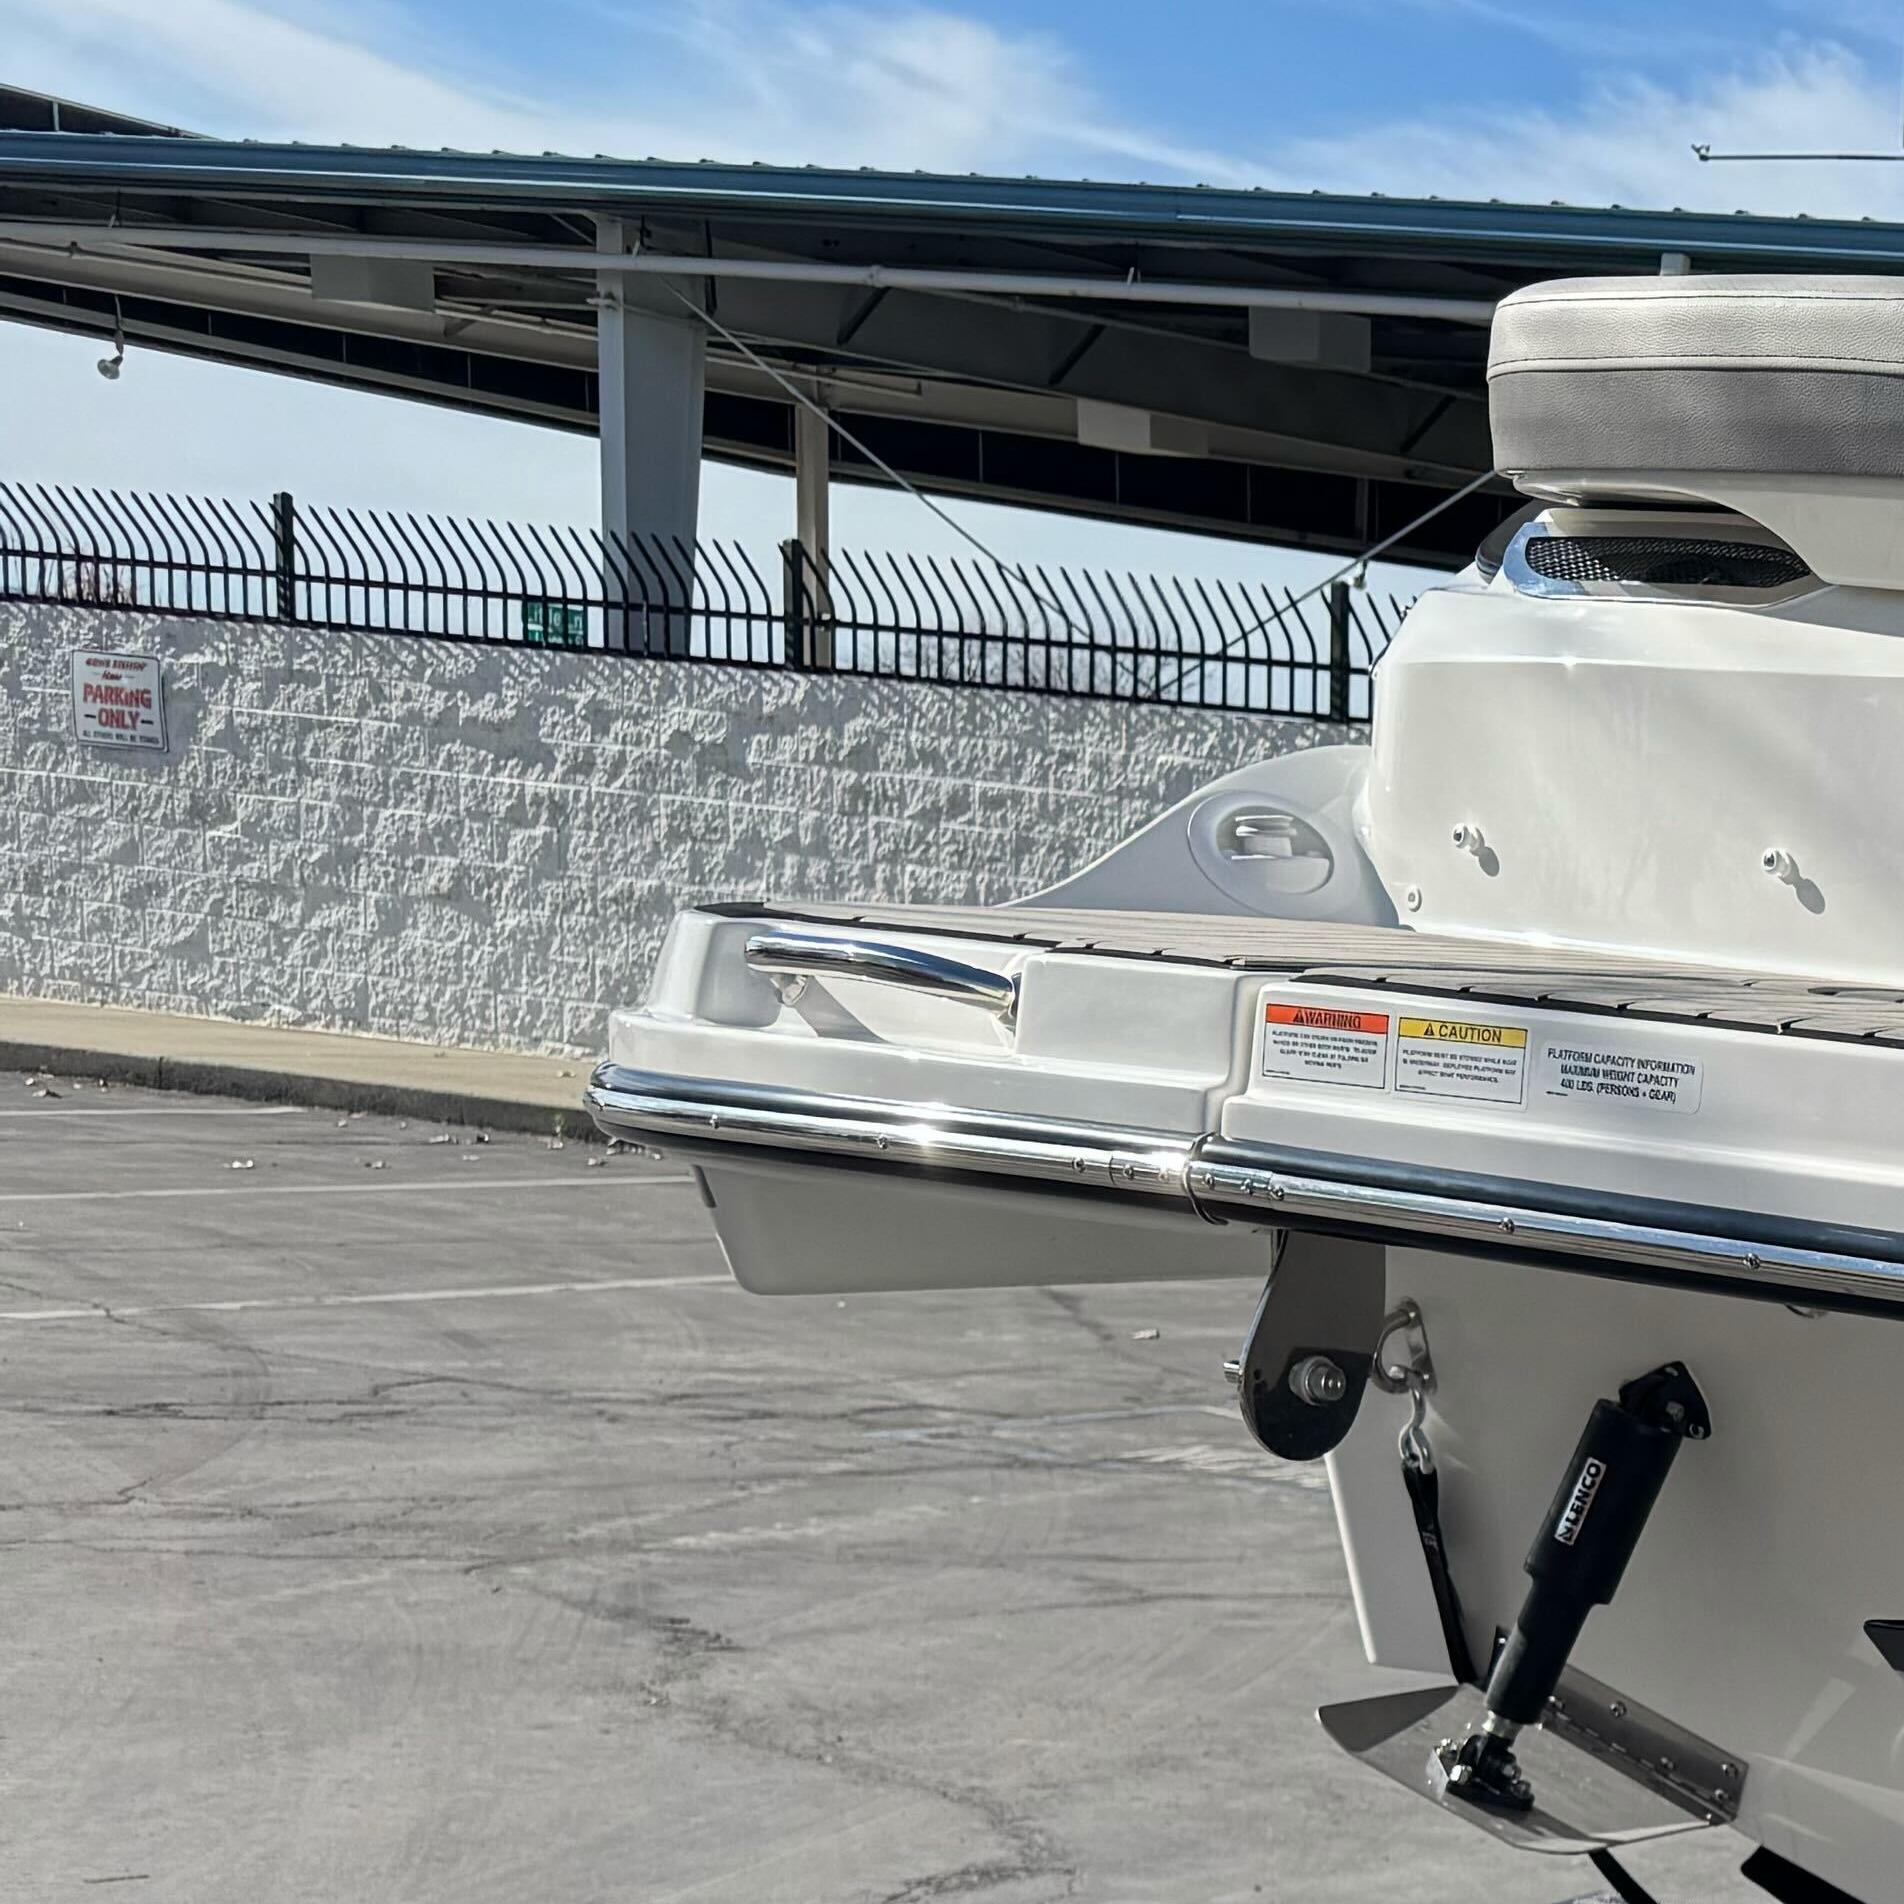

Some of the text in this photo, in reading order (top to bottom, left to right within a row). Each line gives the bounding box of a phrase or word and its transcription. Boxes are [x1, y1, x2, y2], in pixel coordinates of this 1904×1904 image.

[82, 682, 153, 710] PARKING
[97, 707, 141, 731] ONLY
[1303, 1009, 1362, 1029] WARNING
[1438, 1024, 1503, 1043] CAUTION
[1593, 1053, 1635, 1068] CAPACITY
[1636, 1072, 1679, 1089] CAPACITY
[1565, 1463, 1601, 1525] LENCO
